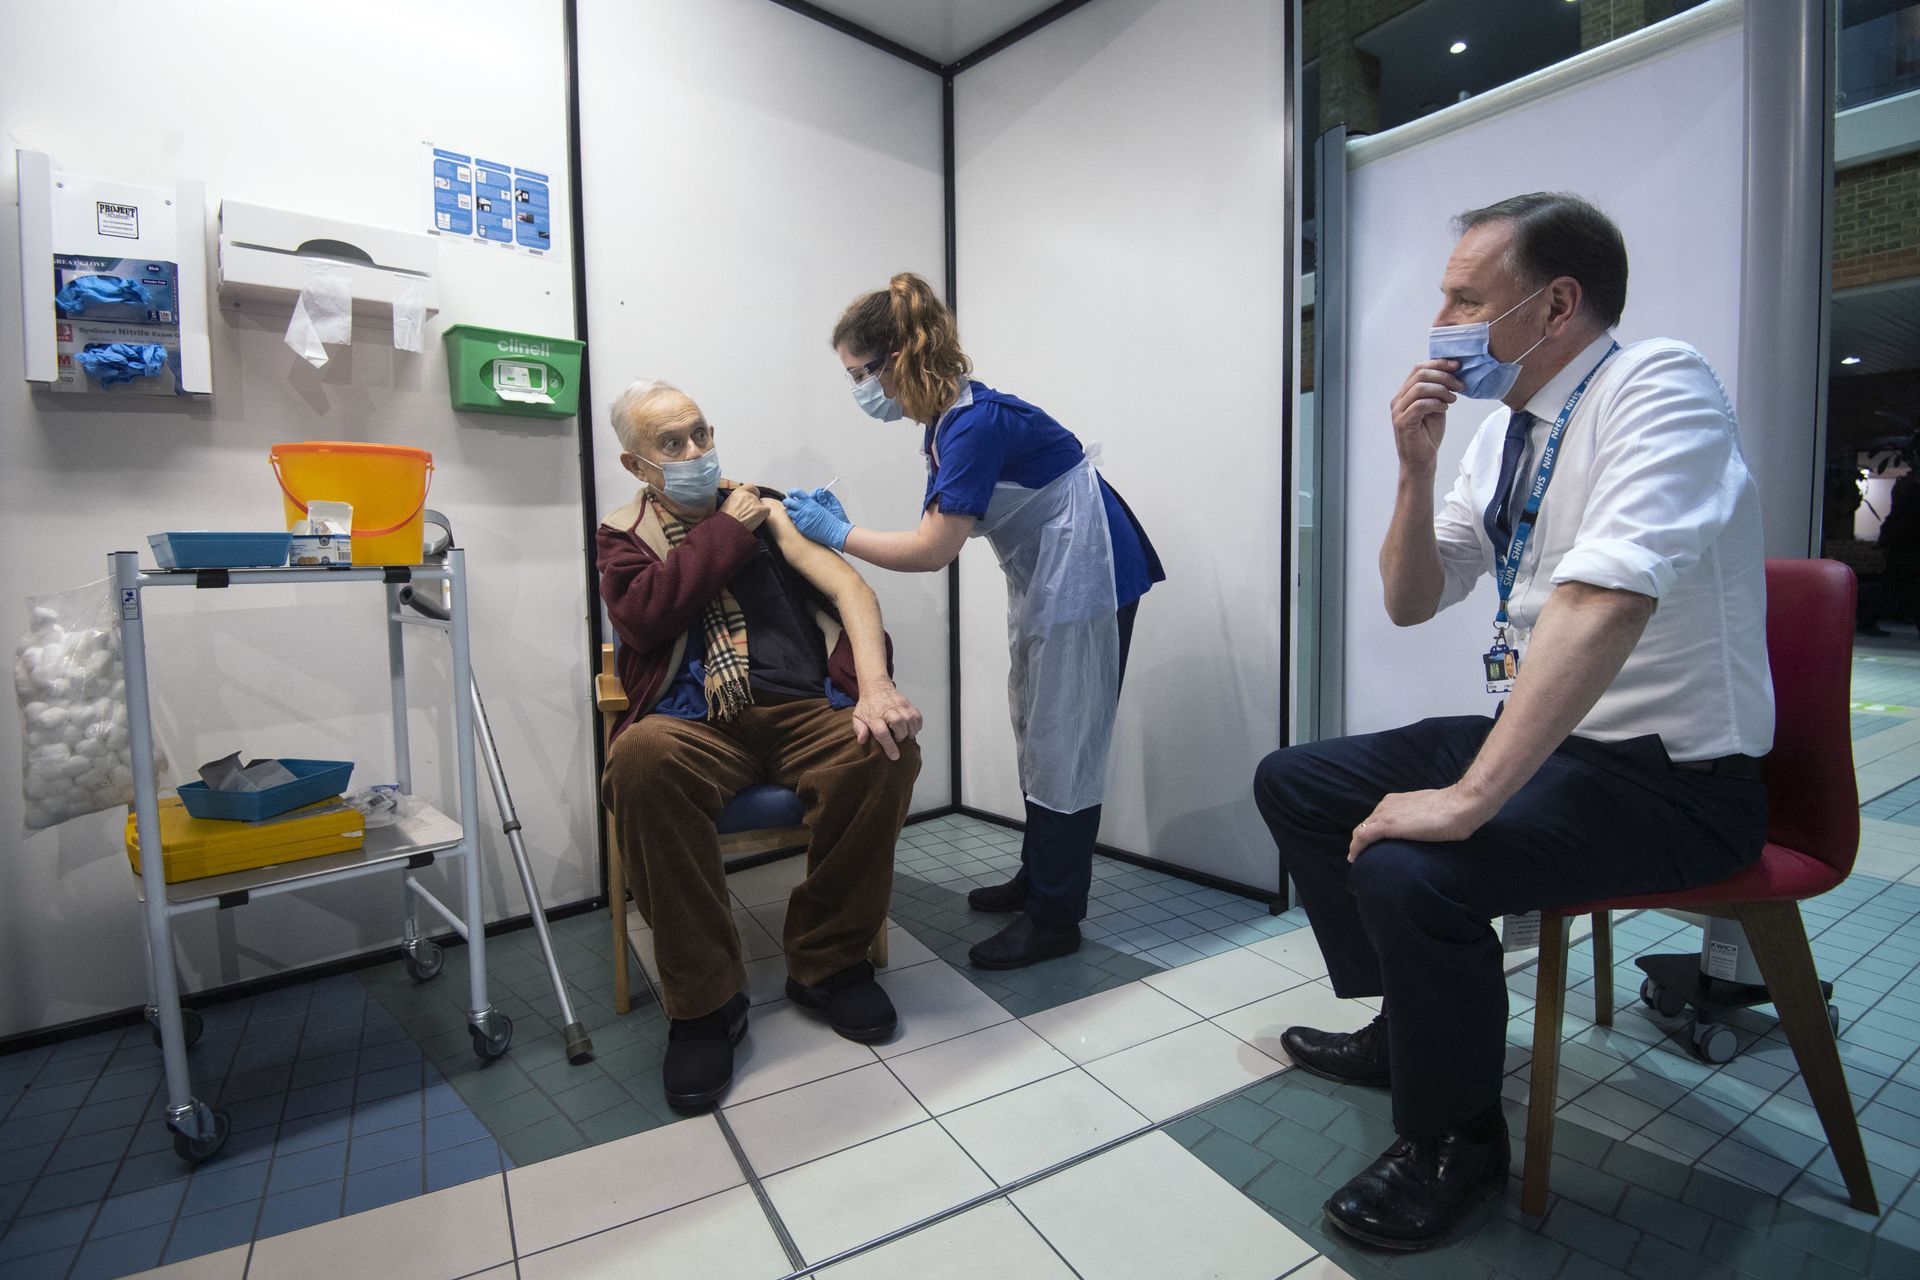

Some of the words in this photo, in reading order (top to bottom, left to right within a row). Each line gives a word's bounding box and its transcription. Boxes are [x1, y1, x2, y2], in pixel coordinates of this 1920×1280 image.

[99, 204, 135, 218] PROJECT
[119, 328, 150, 336] Nitrile
[497, 338, 550, 357] clinell
[1565, 390, 1582, 411] NHS
[1551, 417, 1565, 440] NHS
[1542, 447, 1554, 469] NHS
[1533, 475, 1546, 498] NHS
[1512, 539, 1524, 561] NHS
[1503, 566, 1516, 587] NHS
